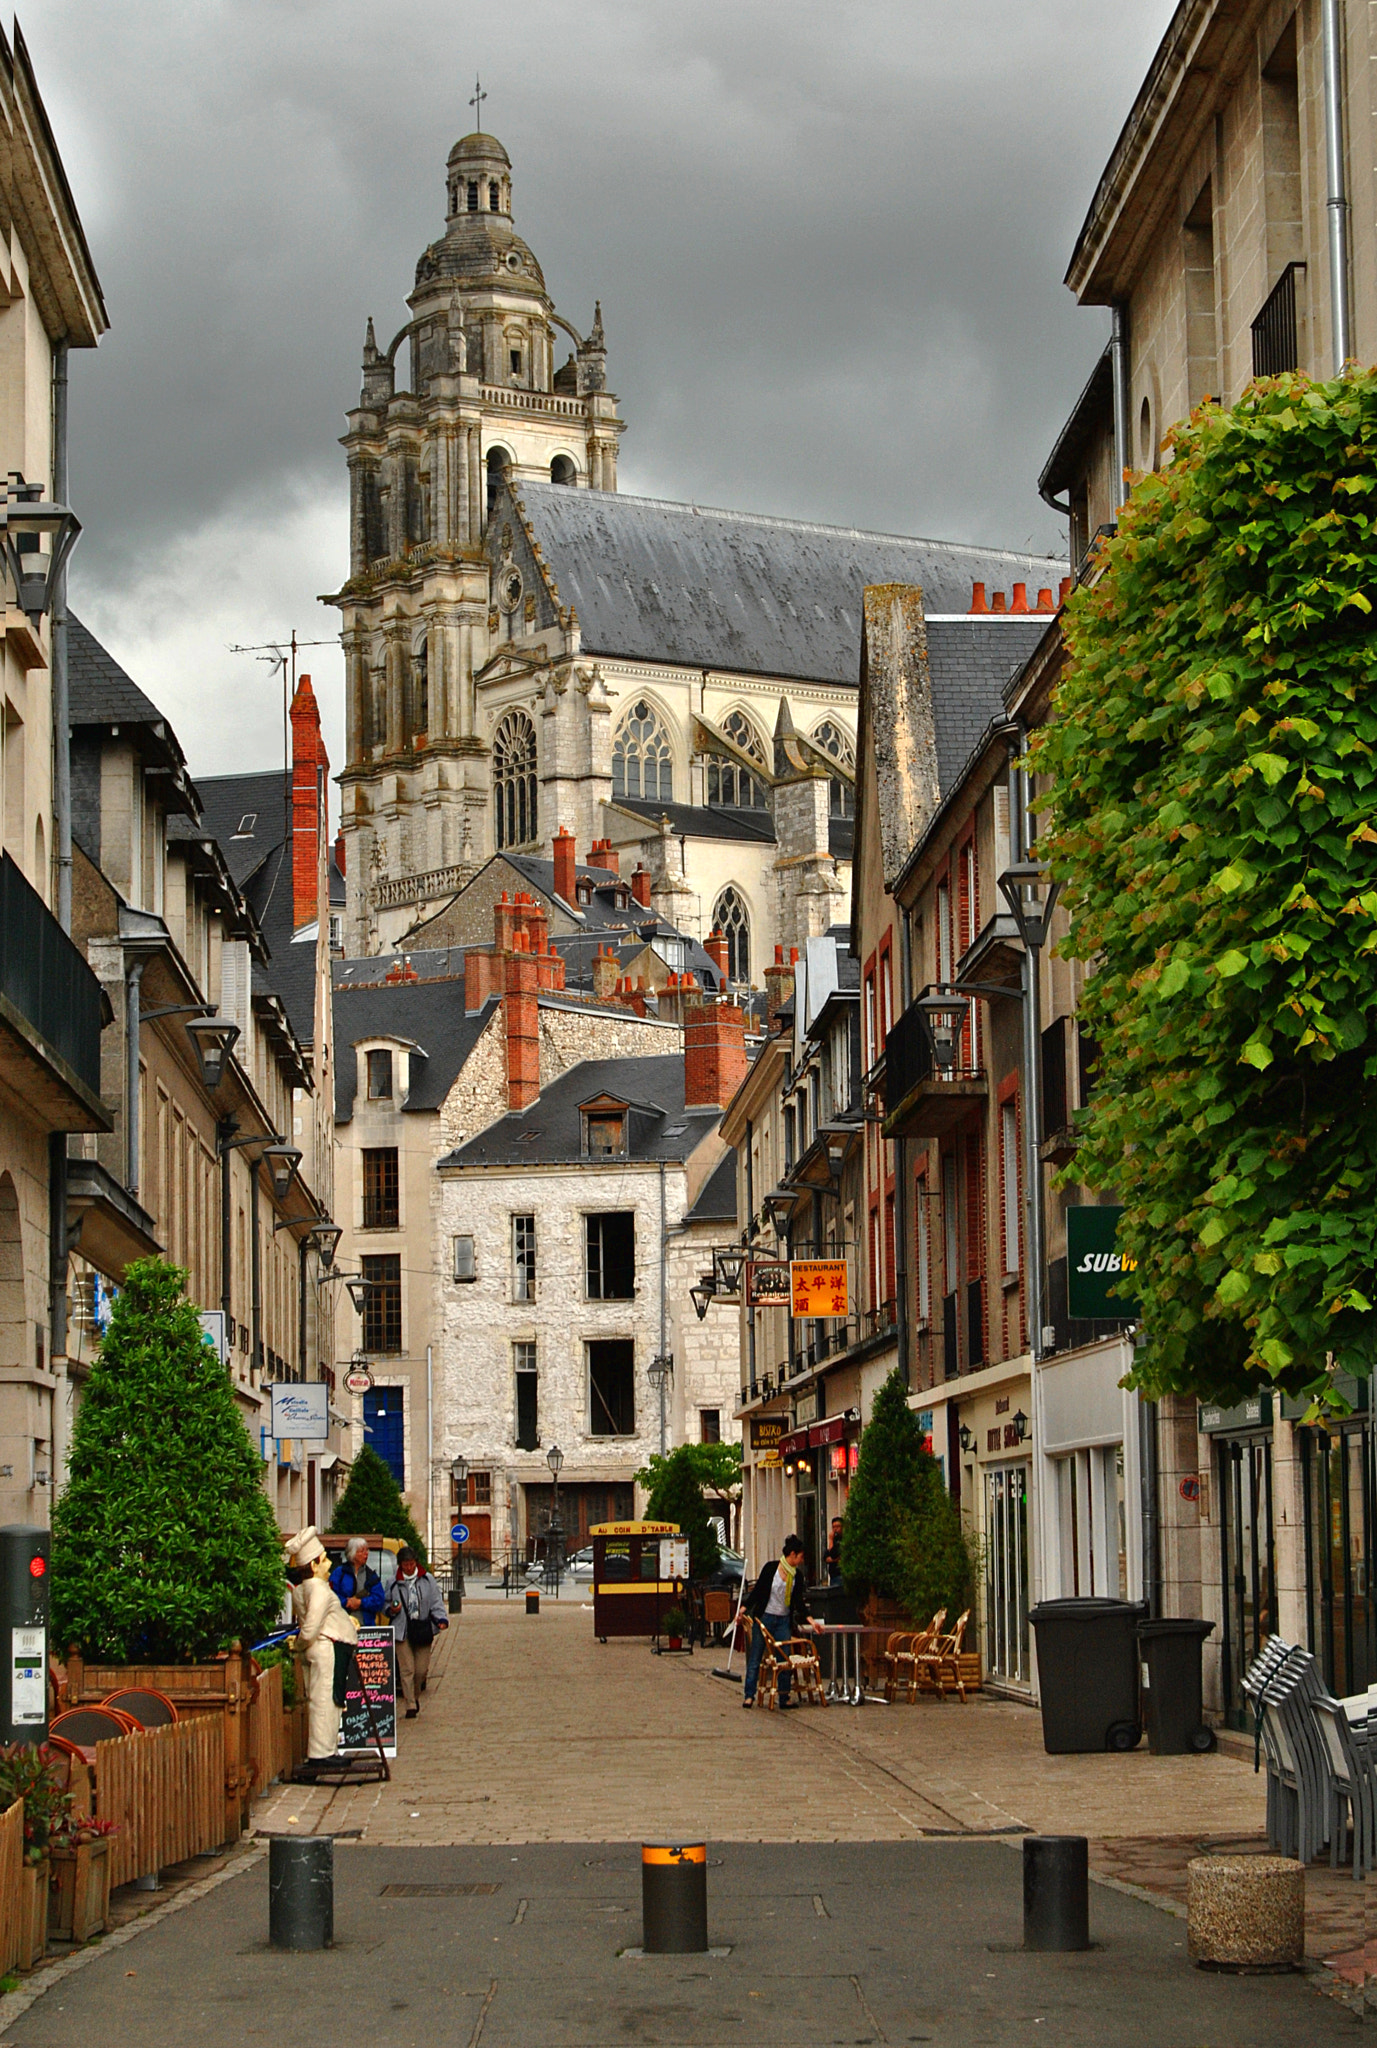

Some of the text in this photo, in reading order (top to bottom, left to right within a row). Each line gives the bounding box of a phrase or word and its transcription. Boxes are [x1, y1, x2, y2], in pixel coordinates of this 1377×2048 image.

[792, 1264, 845, 1272] RESTAURANT
[1076, 1253, 1139, 1273] SUBW
[795, 1275, 845, 1292] 太平洋
[795, 1295, 845, 1313] 酒家
[758, 1424, 782, 1437] BISTRO
[641, 1525, 673, 1533] D'TABLE
[357, 1661, 389, 1670] AUFRES
[363, 1677, 388, 1686] LACES
